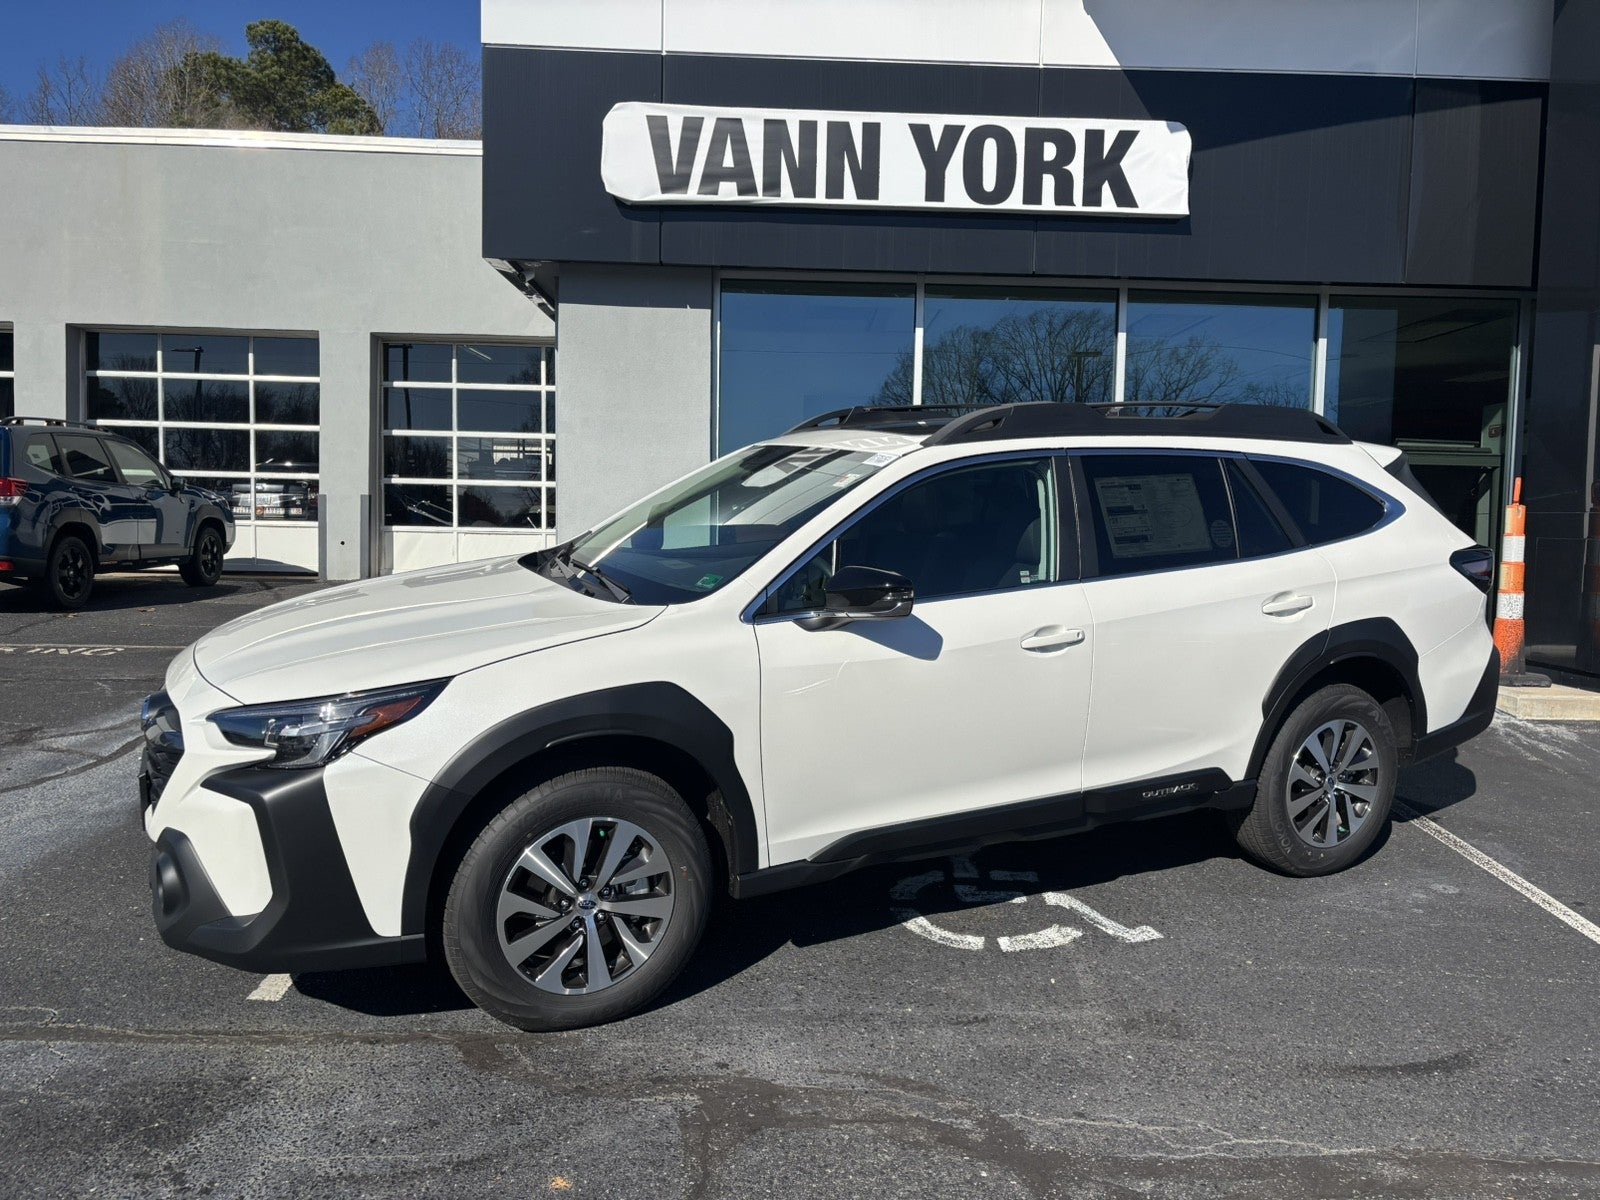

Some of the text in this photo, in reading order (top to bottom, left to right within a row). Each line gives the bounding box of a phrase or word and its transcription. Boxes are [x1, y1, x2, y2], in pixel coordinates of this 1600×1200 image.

[646, 115, 1140, 209] VANN YORK
[1142, 782, 1199, 798] OUTBACK
